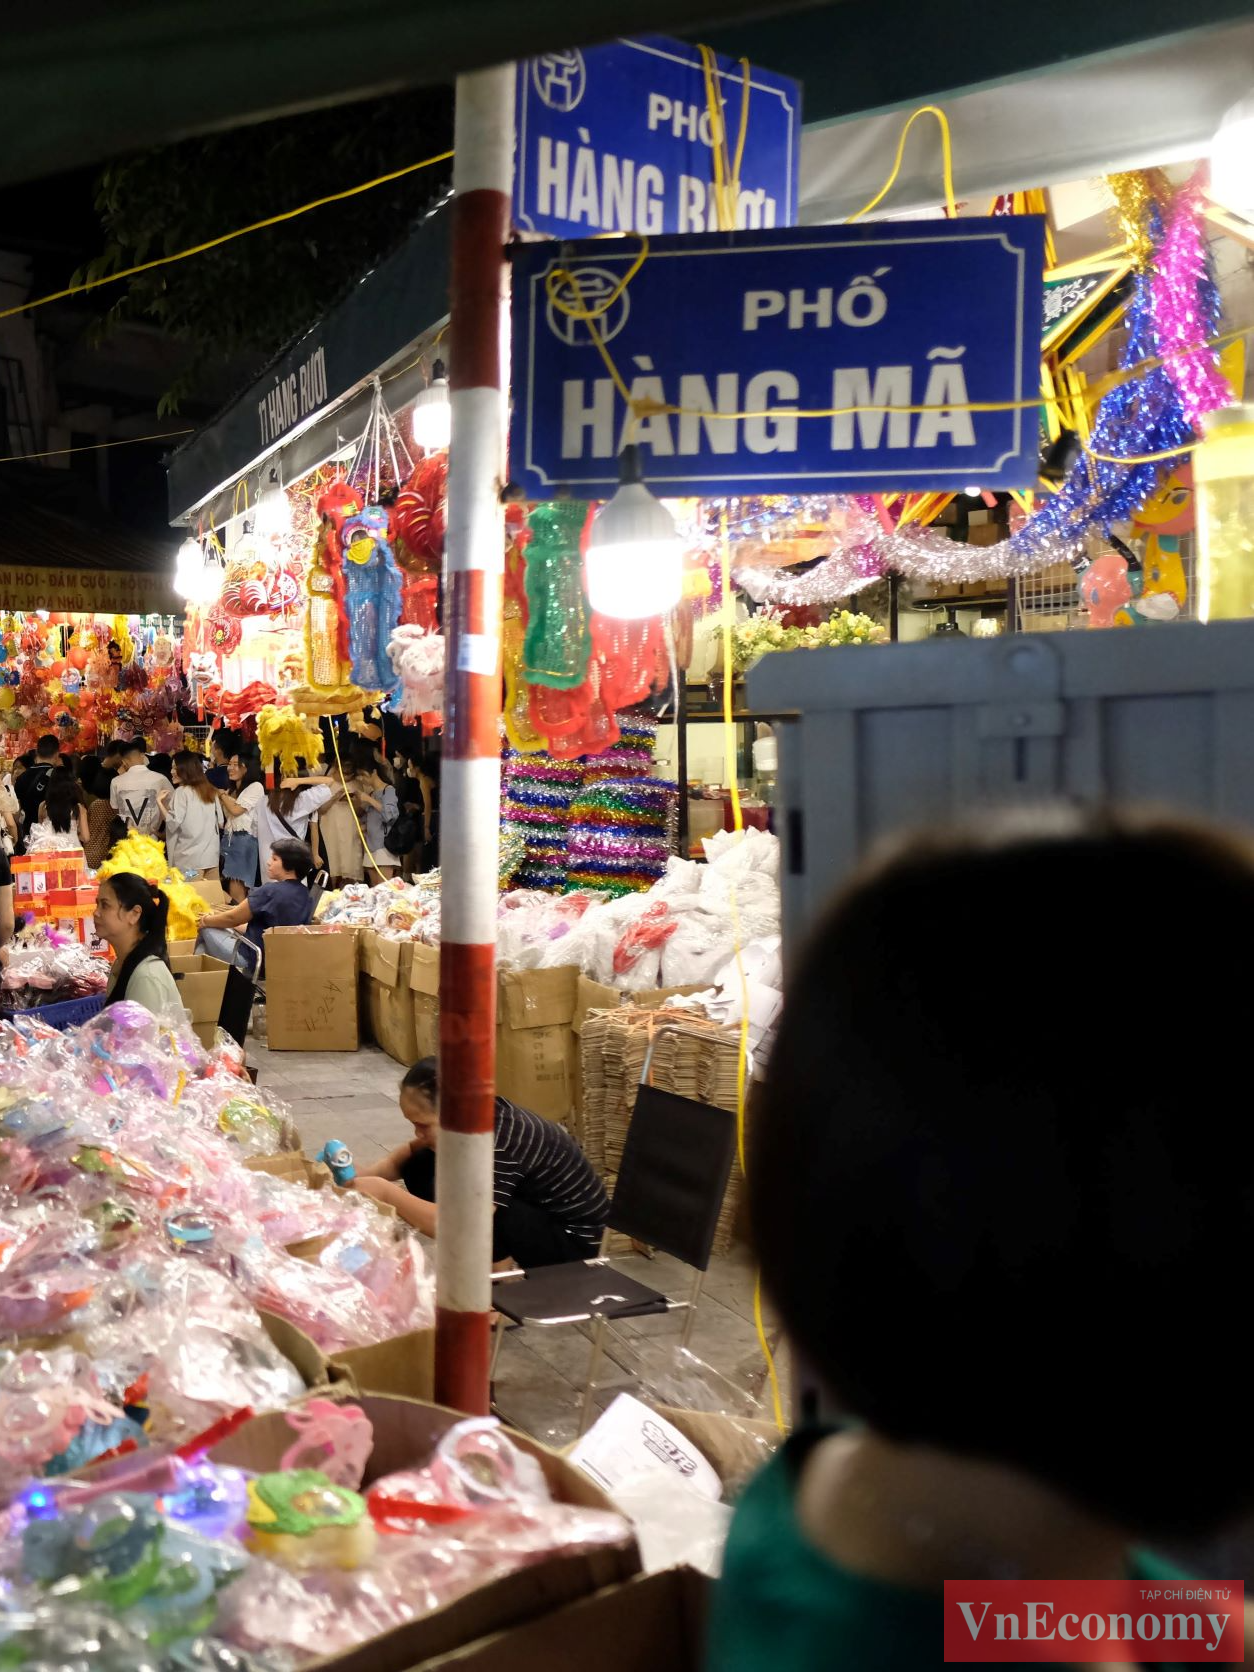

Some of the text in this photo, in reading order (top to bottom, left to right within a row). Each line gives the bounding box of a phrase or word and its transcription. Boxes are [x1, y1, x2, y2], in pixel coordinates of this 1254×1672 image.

[537, 127, 665, 234] HÀNG
[742, 266, 892, 331] PHỐ
[267, 373, 298, 439] HÀNG
[561, 345, 976, 459] HÀNG MÃ
